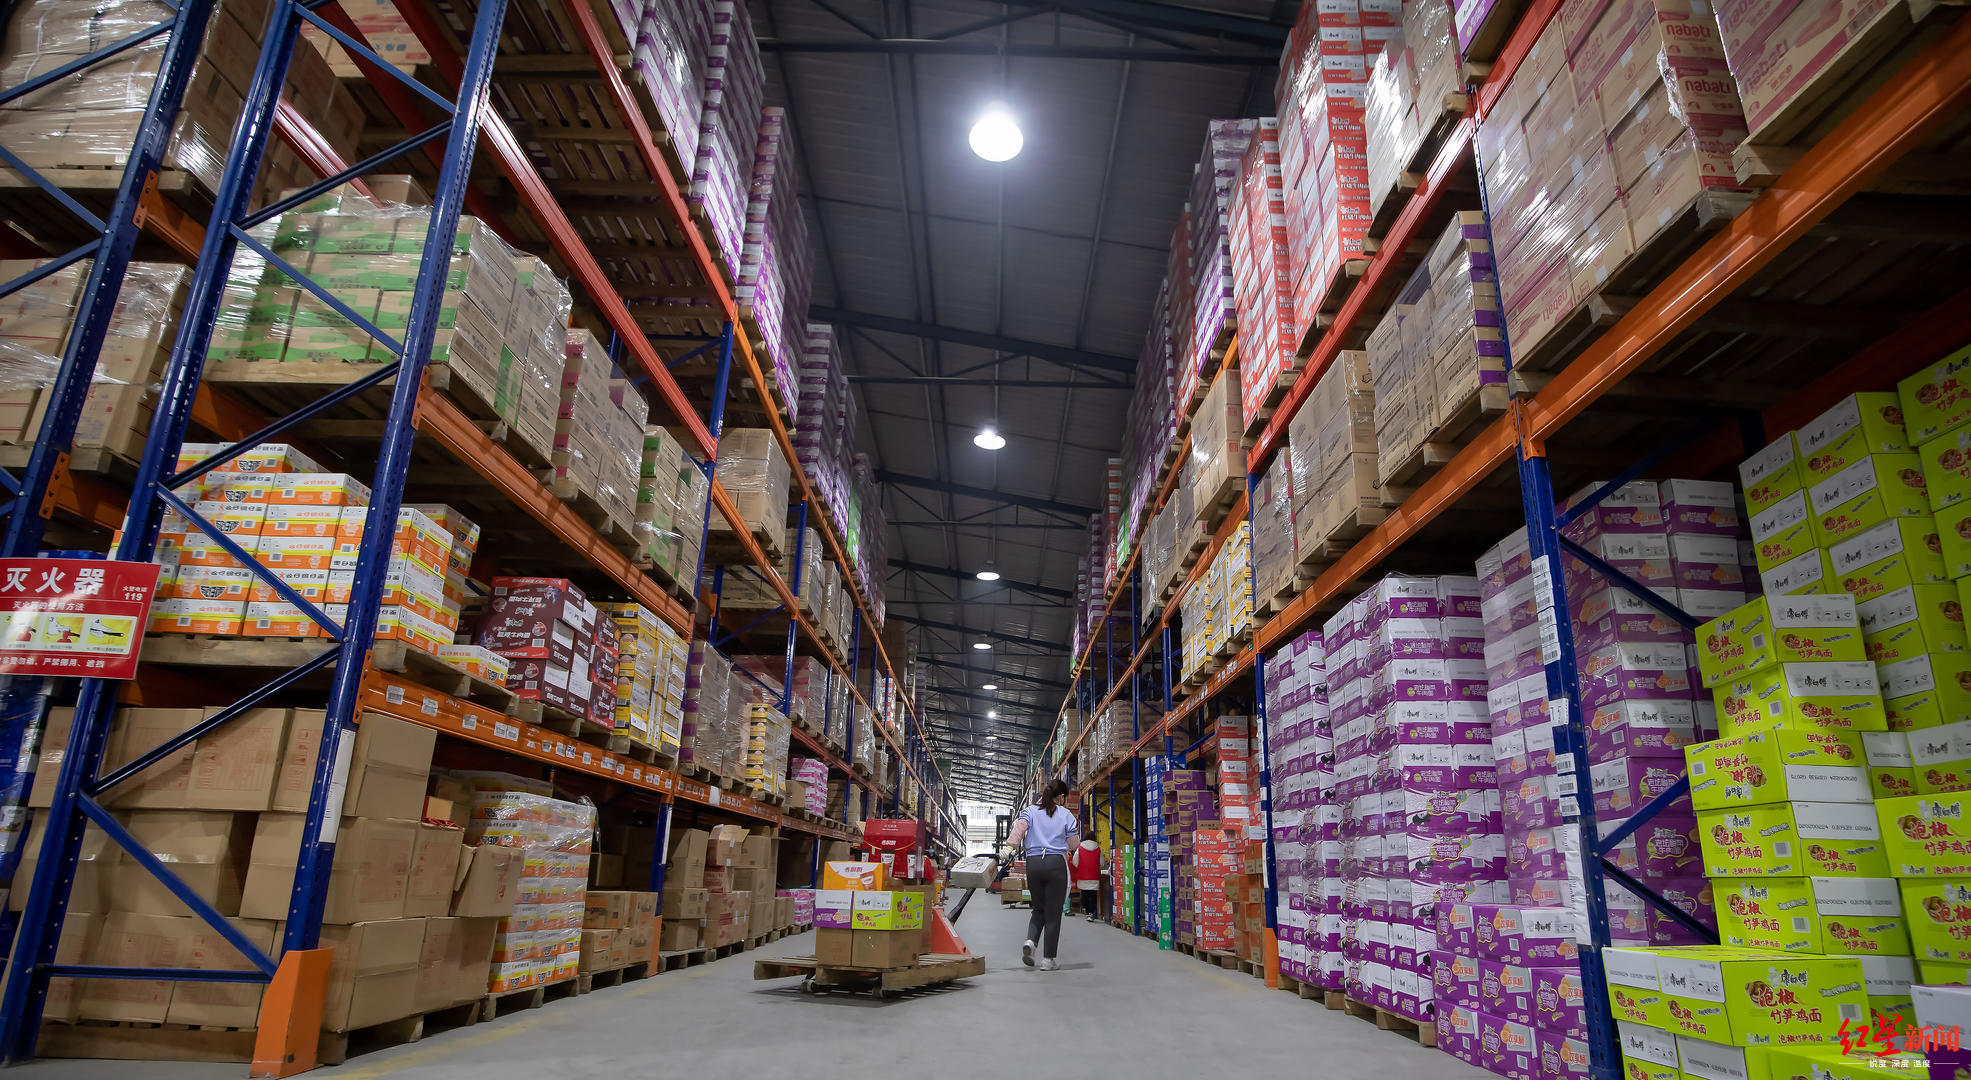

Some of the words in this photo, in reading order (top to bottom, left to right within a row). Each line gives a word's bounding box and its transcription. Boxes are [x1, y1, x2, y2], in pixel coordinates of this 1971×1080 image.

[1666, 24, 1711, 38] nabati
[1744, 39, 1790, 94] nabati
[1685, 80, 1730, 94] nabati
[1, 566, 105, 595] 灭火器
[124, 592, 143, 601] 119
[1932, 801, 1961, 819] 康师傅
[1732, 814, 1751, 829] 康师傅
[1910, 820, 1953, 840] 泡椒
[1727, 845, 1762, 860] 竹笋鸡面
[1823, 862, 1857, 873] 竹笋鸡面
[1749, 885, 1768, 900] 康师傅
[1743, 917, 1780, 931] 竹笋鸡面
[1780, 968, 1808, 987] 康师傅
[1759, 987, 1798, 1007] 泡椒
[1770, 1008, 1822, 1024] 竹笋鸡面
[1778, 1034, 1823, 1044] 泡椒竹笋鸡面
